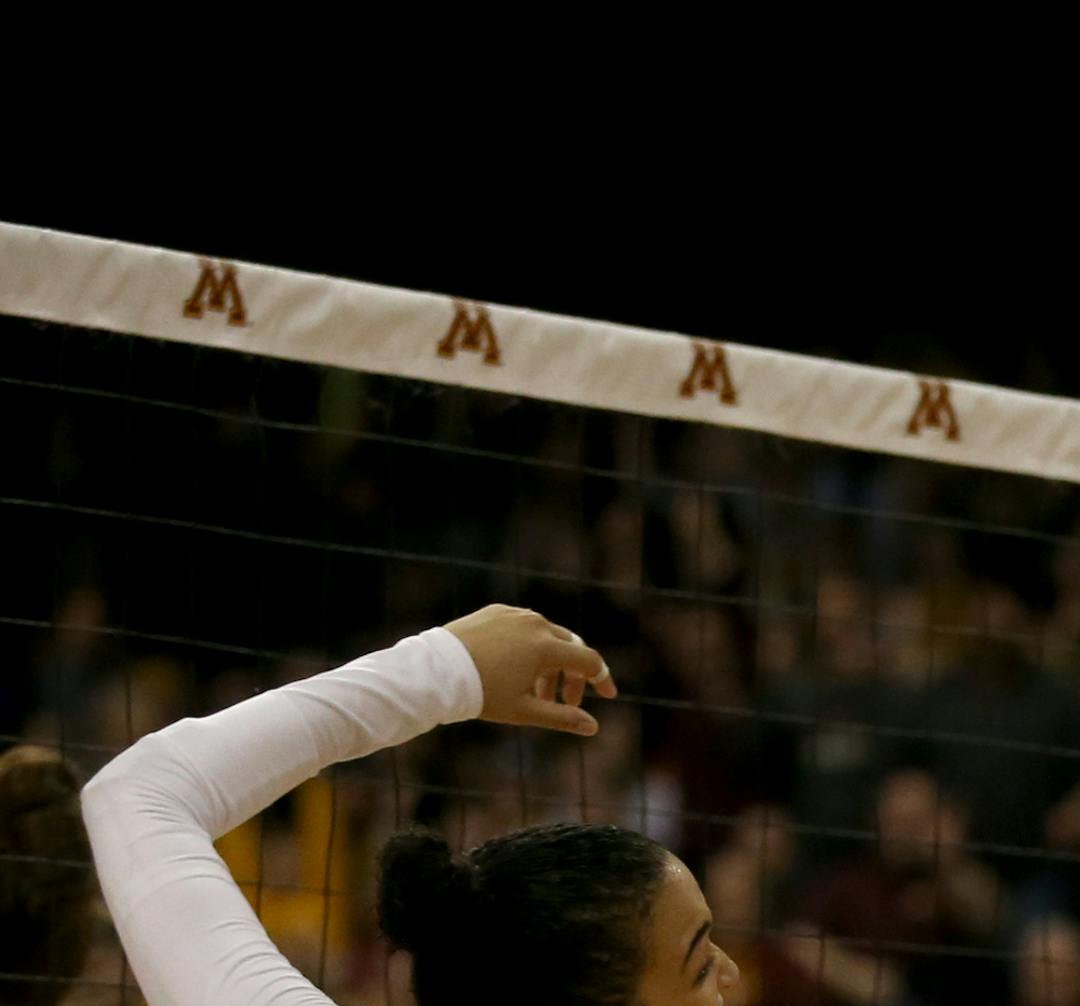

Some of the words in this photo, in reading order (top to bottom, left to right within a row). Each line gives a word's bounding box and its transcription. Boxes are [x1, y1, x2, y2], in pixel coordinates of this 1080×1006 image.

[183, 257, 247, 325] M
[438, 297, 502, 365] M
[680, 338, 739, 405] M
[906, 376, 961, 440] M
